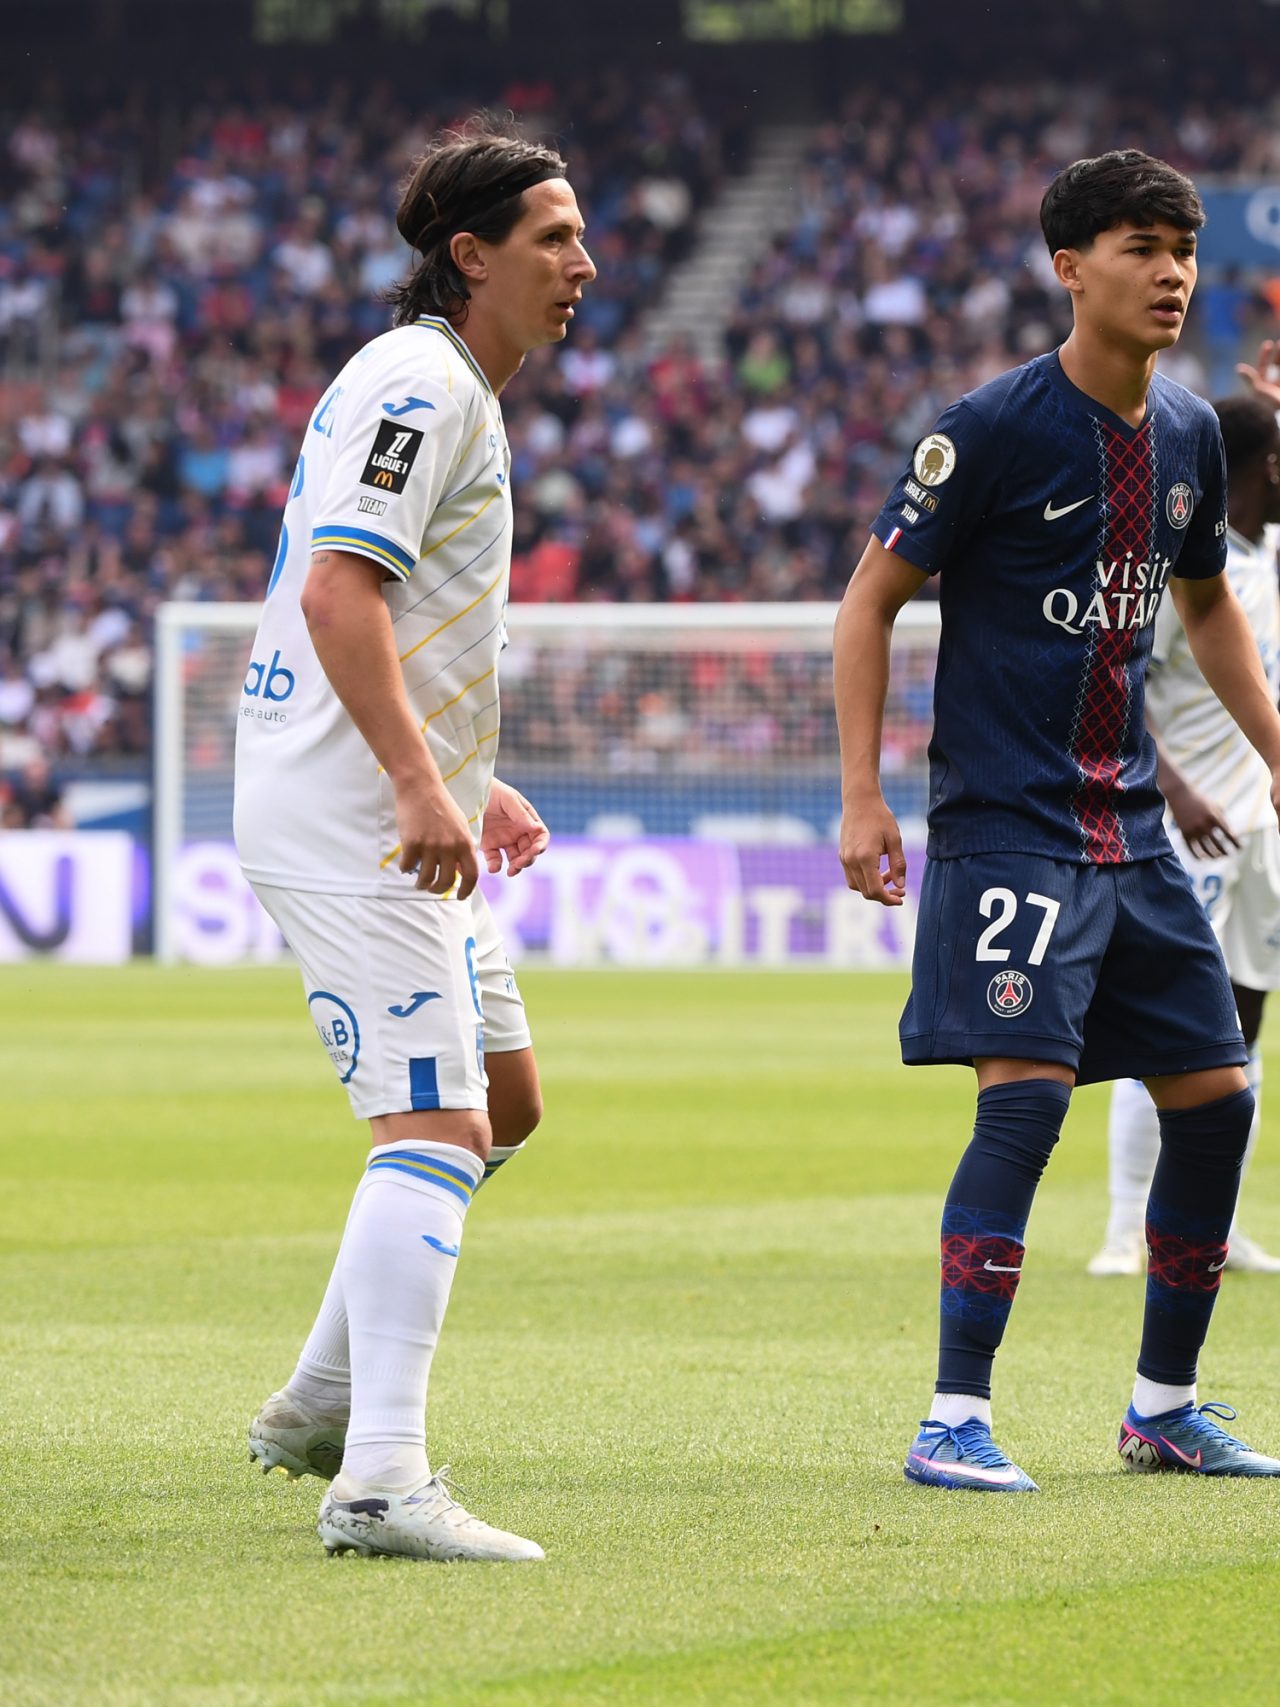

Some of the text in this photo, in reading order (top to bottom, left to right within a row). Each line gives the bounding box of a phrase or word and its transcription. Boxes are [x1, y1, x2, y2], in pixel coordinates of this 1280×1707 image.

[1171, 485, 1190, 497] PARIS
[1096, 551, 1171, 590] visit
[1042, 588, 1160, 635] QATAR
[257, 710, 287, 722] auto
[976, 887, 1061, 966] 27
[995, 973, 1025, 985] PARIS
